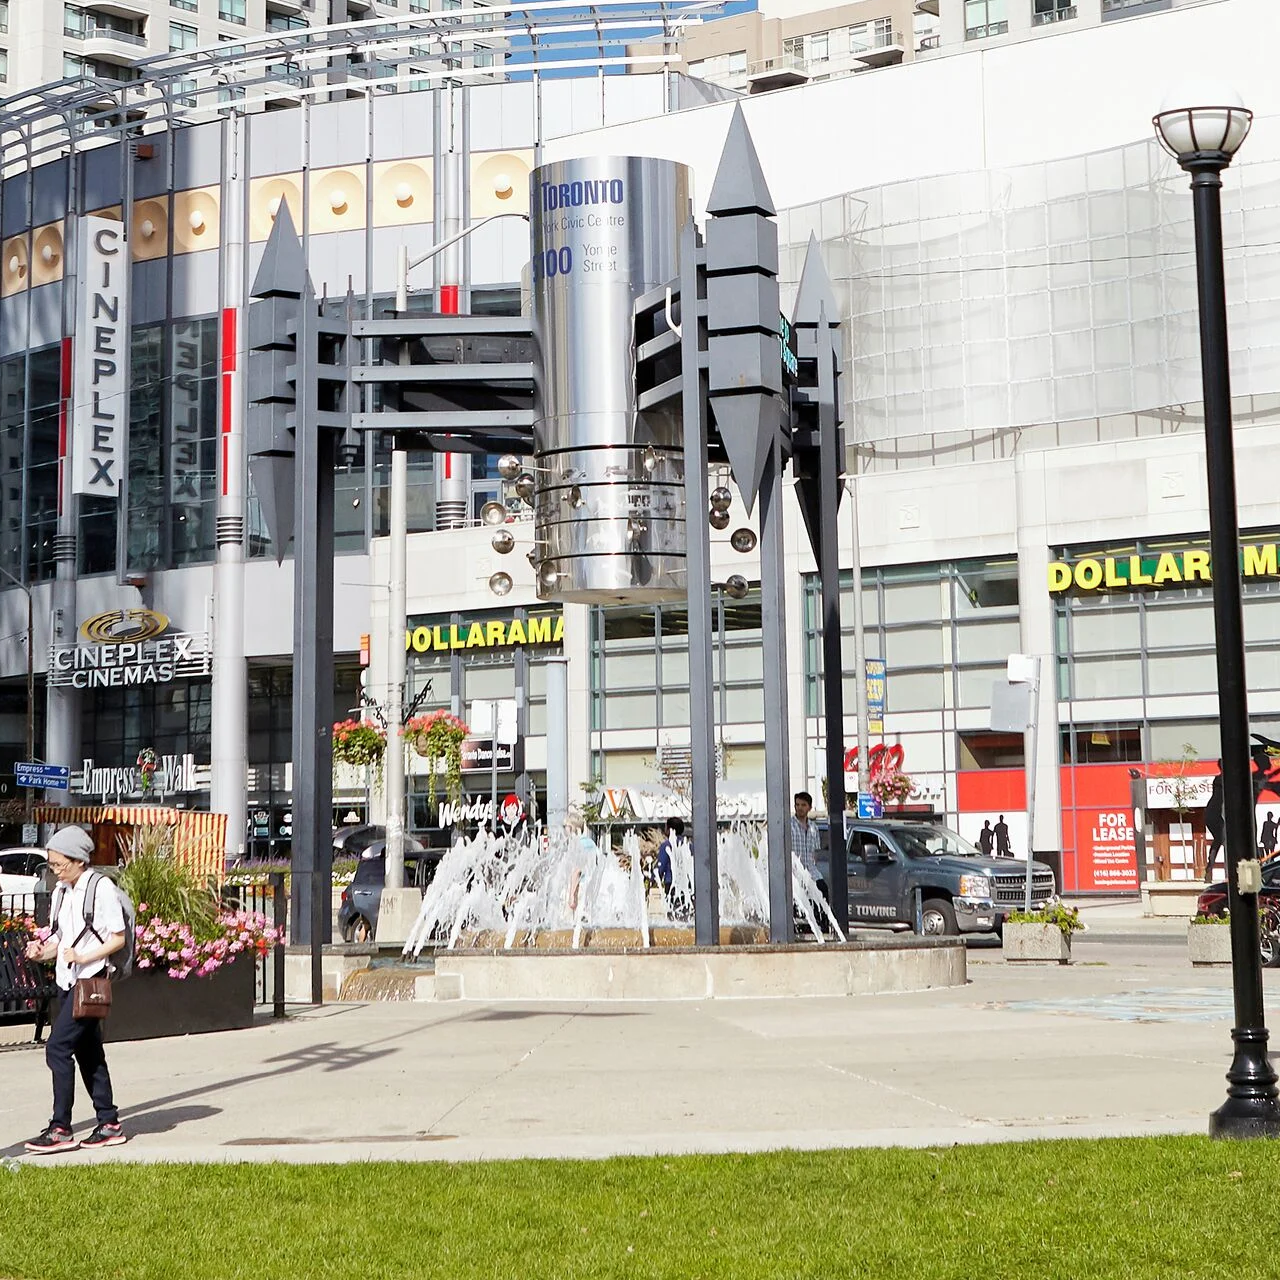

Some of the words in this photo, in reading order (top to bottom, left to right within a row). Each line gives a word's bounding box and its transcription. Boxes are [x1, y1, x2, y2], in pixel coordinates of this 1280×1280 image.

[541, 179, 624, 212] TORONTO
[561, 216, 585, 231] Civic
[89, 229, 119, 488] CINEPLEX
[406, 616, 564, 653] OLLARAMA
[54, 637, 193, 671] CINEPLEX
[71, 663, 176, 689] CINEMAS
[16, 763, 44, 774] Empress
[82, 758, 135, 804] Empress
[161, 753, 196, 792] Walk
[28, 775, 43, 785] Park
[42, 778, 60, 787] Home
[1098, 813, 1127, 828] FOR
[1092, 827, 1135, 842] LEASE
[856, 904, 897, 917] TOWING
